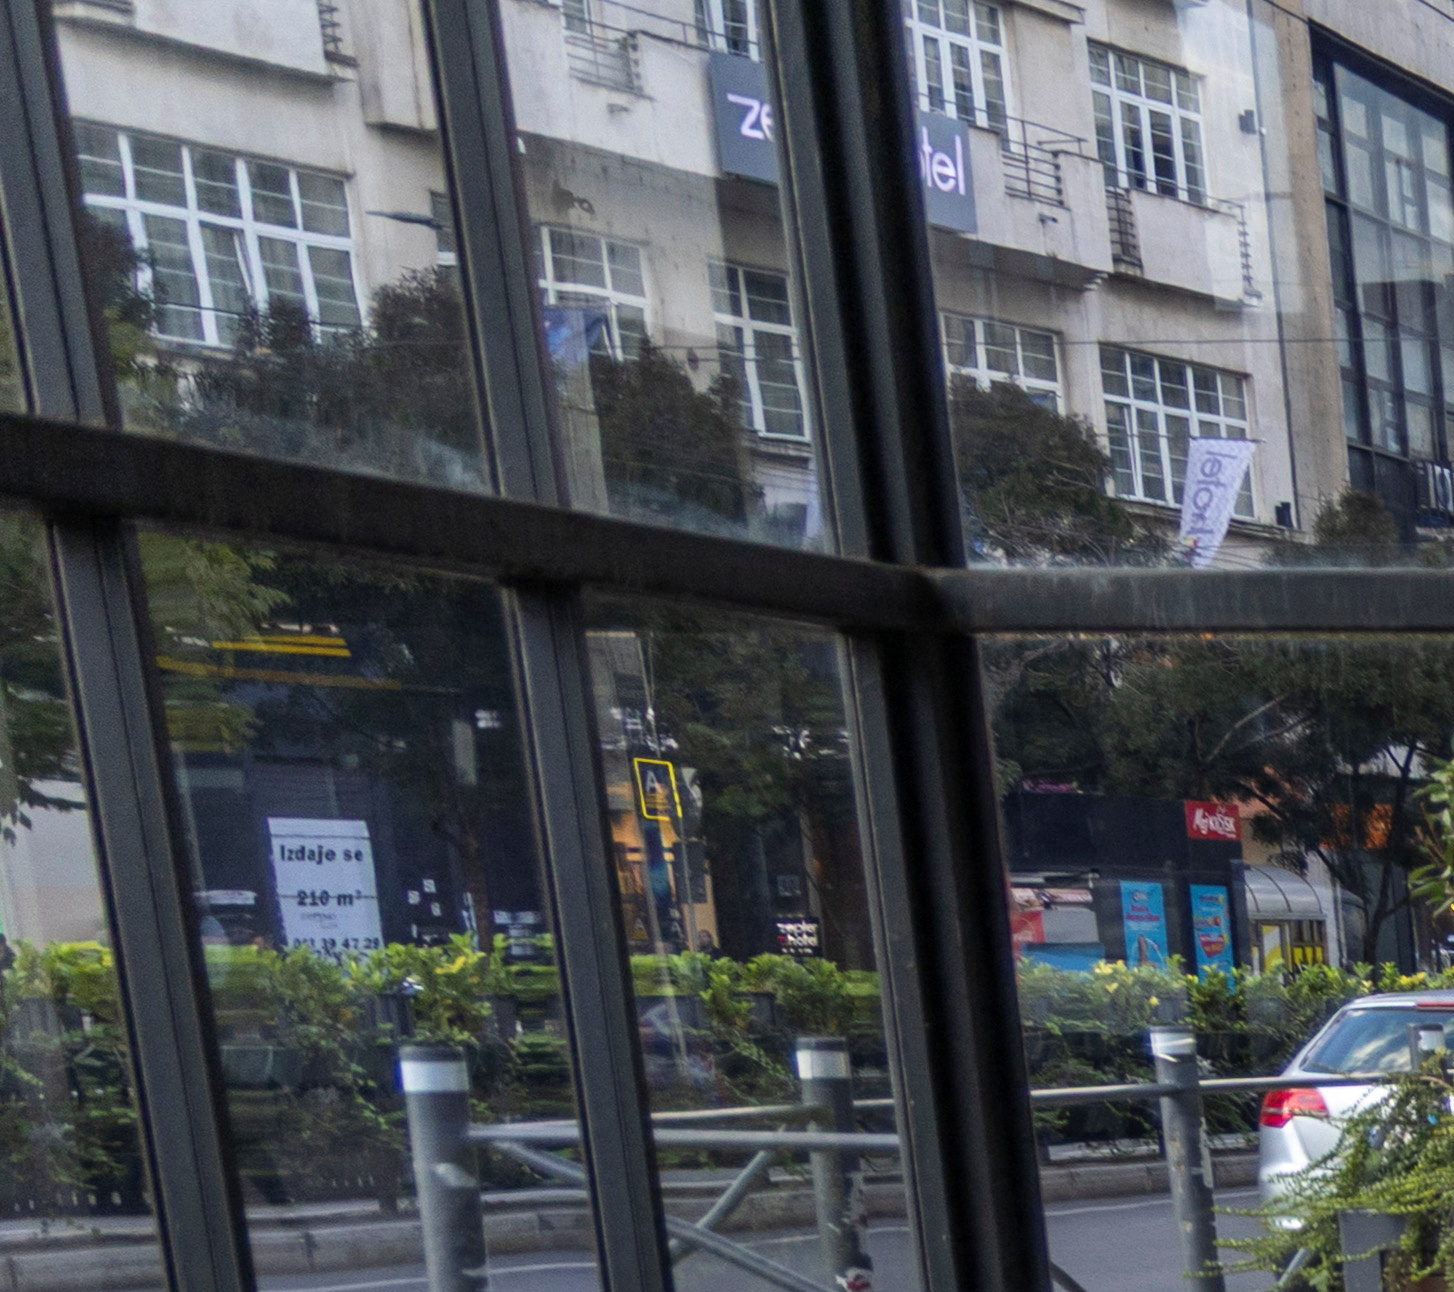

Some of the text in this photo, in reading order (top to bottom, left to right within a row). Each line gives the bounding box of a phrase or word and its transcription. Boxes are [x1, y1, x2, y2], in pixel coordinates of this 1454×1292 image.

[919, 126, 966, 196] tel
[280, 844, 363, 866] Izdaje se
